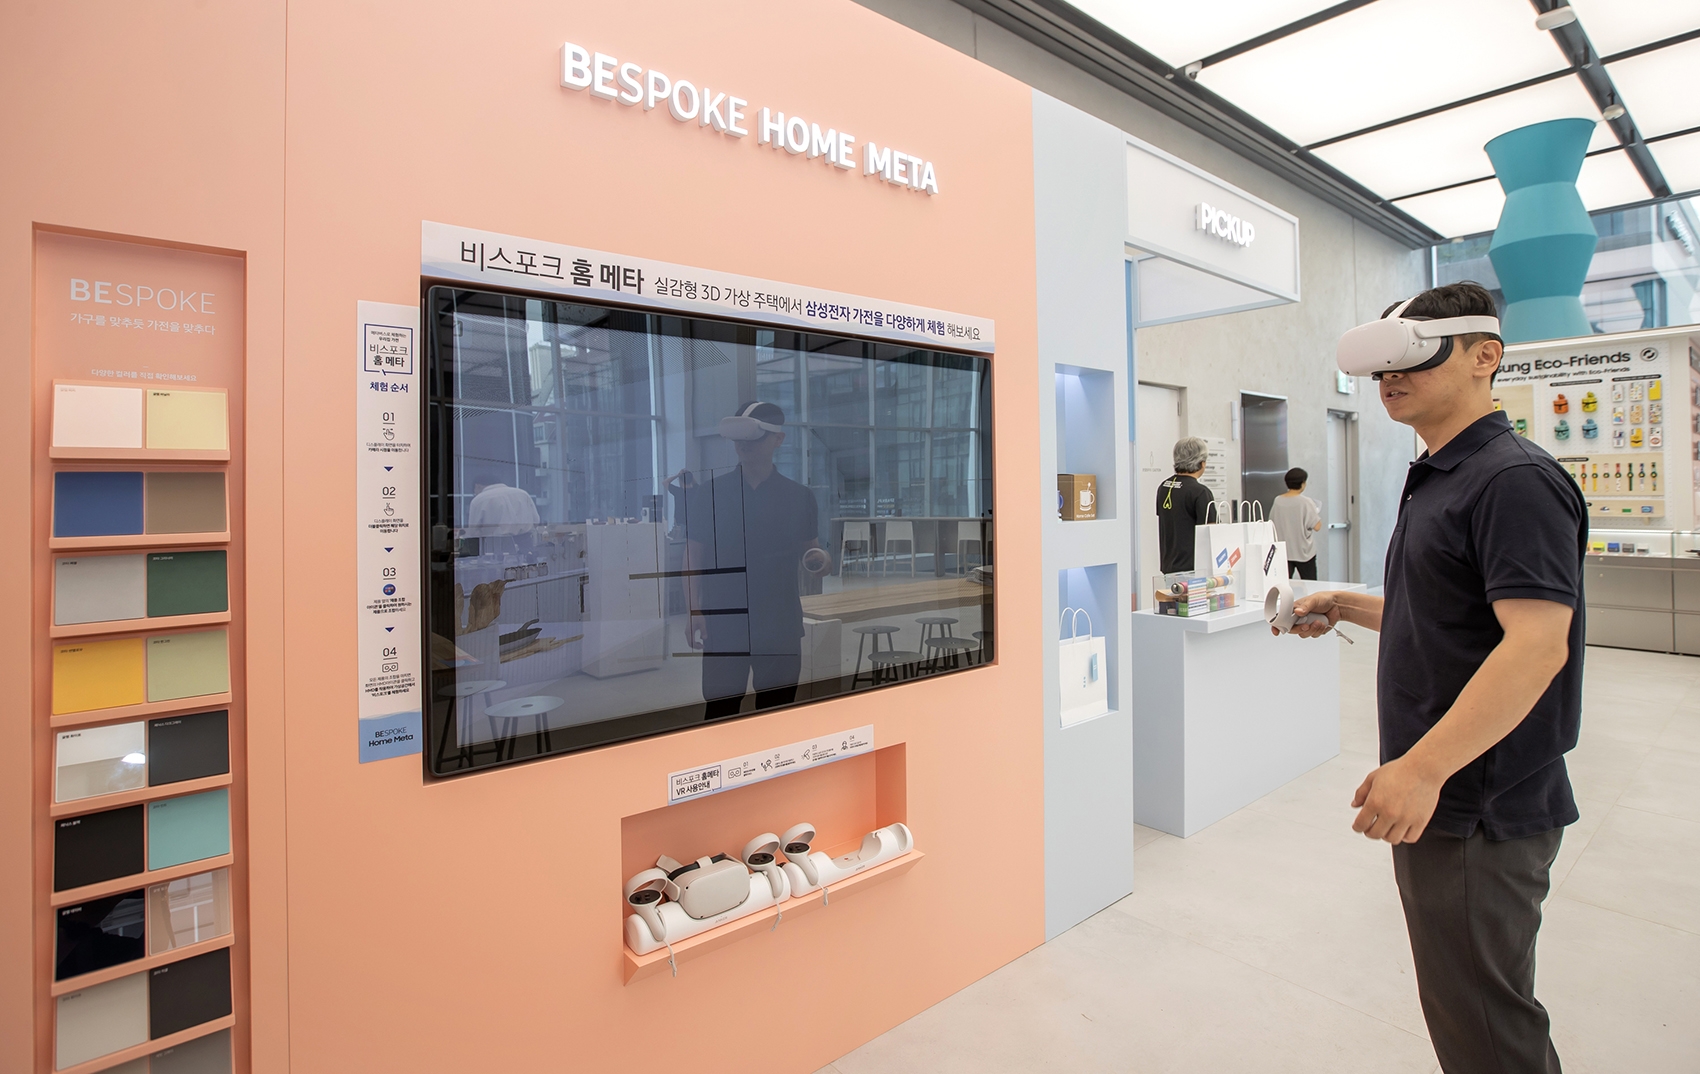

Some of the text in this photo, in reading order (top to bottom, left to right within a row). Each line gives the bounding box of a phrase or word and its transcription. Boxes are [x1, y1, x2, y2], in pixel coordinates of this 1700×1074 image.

[560, 42, 939, 196] BESPOKE HOME META
[1195, 201, 1255, 248] PICKUP
[70, 278, 216, 315] BESPOKE
[461, 241, 981, 341] 비스포크 홈 메타 실감형 3D 가상 주택에서 삼성전자 가전을 다양하게 체험 해보세요
[70, 312, 216, 336] 가구를 맞추듯 가전을 맞추다
[369, 344, 408, 355] 비스포크
[373, 355, 405, 367] 홈 메타
[1535, 351, 1631, 370] Eco-Friends
[91, 368, 114, 378] 다양한
[370, 381, 409, 393] 체험 순서
[382, 411, 395, 421] 01
[382, 486, 396, 496] 02
[382, 567, 397, 577] 03
[382, 647, 397, 657] 04
[375, 726, 407, 738] BESPOKE
[368, 734, 414, 747] Home Meta
[676, 773, 700, 786] 비스포크
[676, 787, 686, 795] VR
